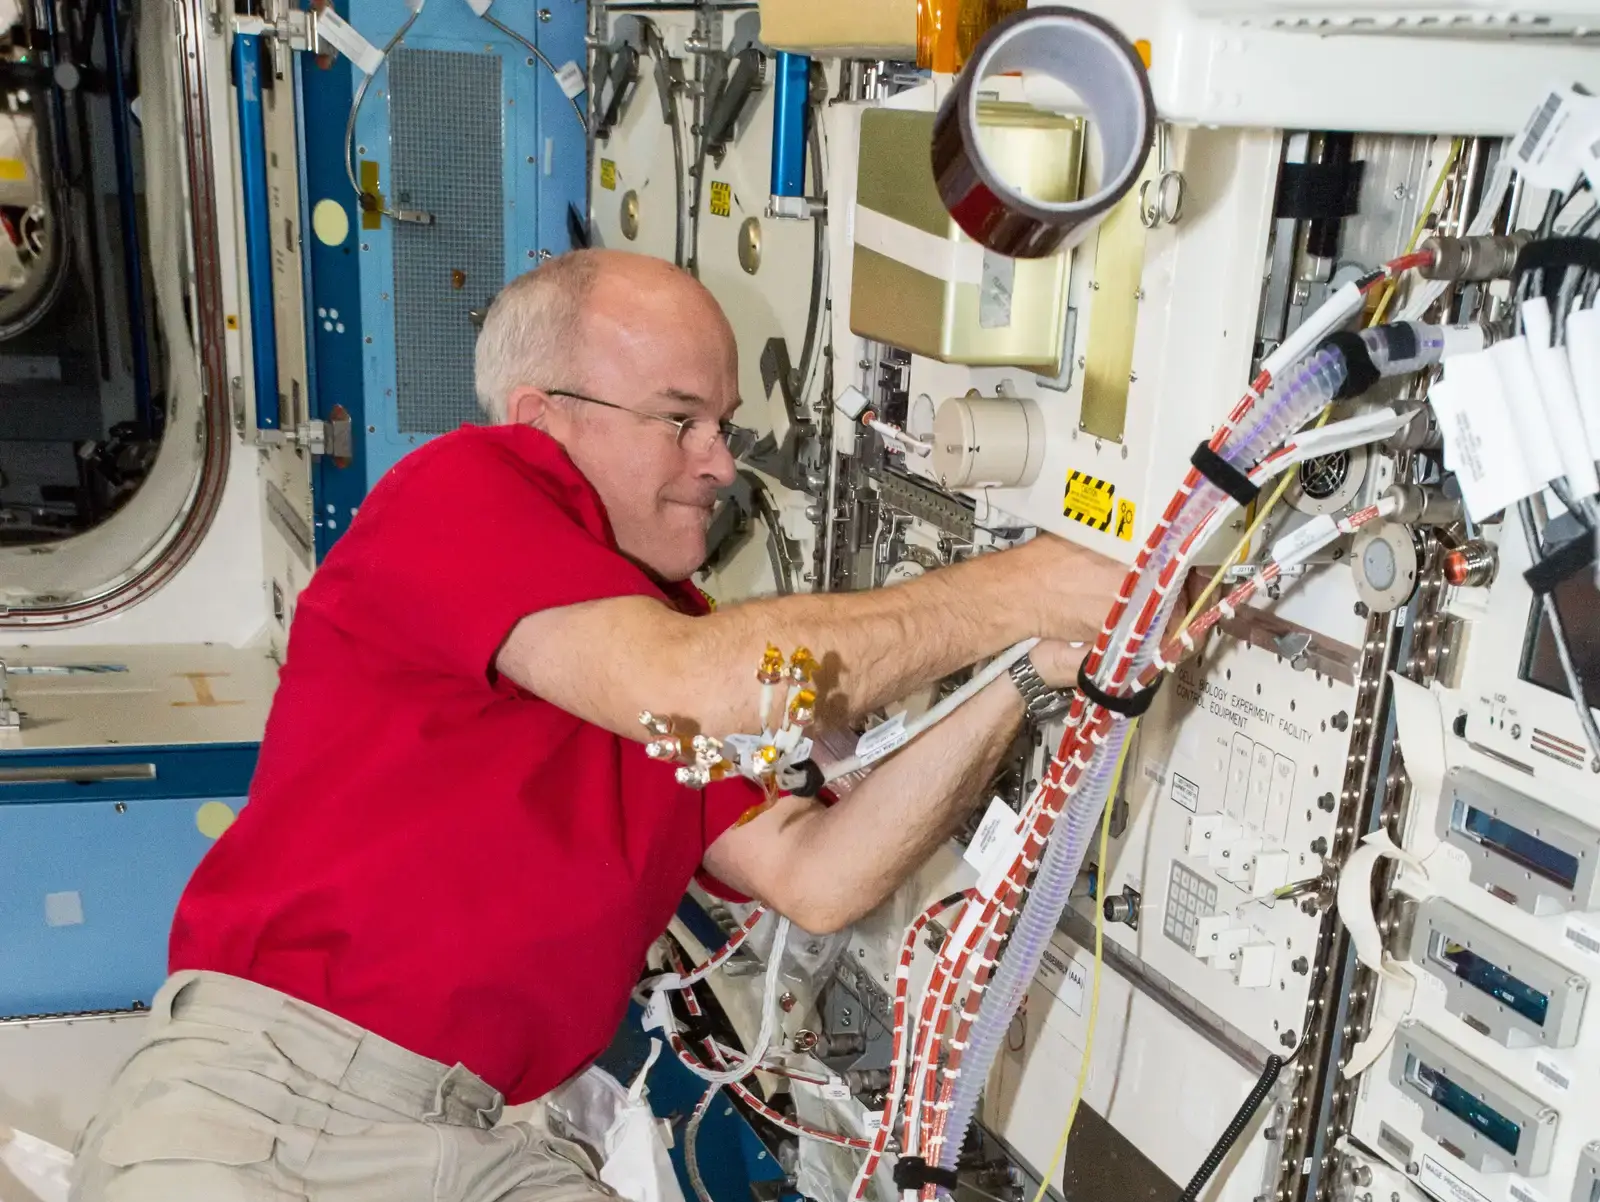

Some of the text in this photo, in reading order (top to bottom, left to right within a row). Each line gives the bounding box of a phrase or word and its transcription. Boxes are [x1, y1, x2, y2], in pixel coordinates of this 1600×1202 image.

[1176, 685, 1249, 729] CONTROL EQUIPMENT
[1179, 669, 1313, 744] CELL BIOLOGY EXPERIMENT FACILITY
